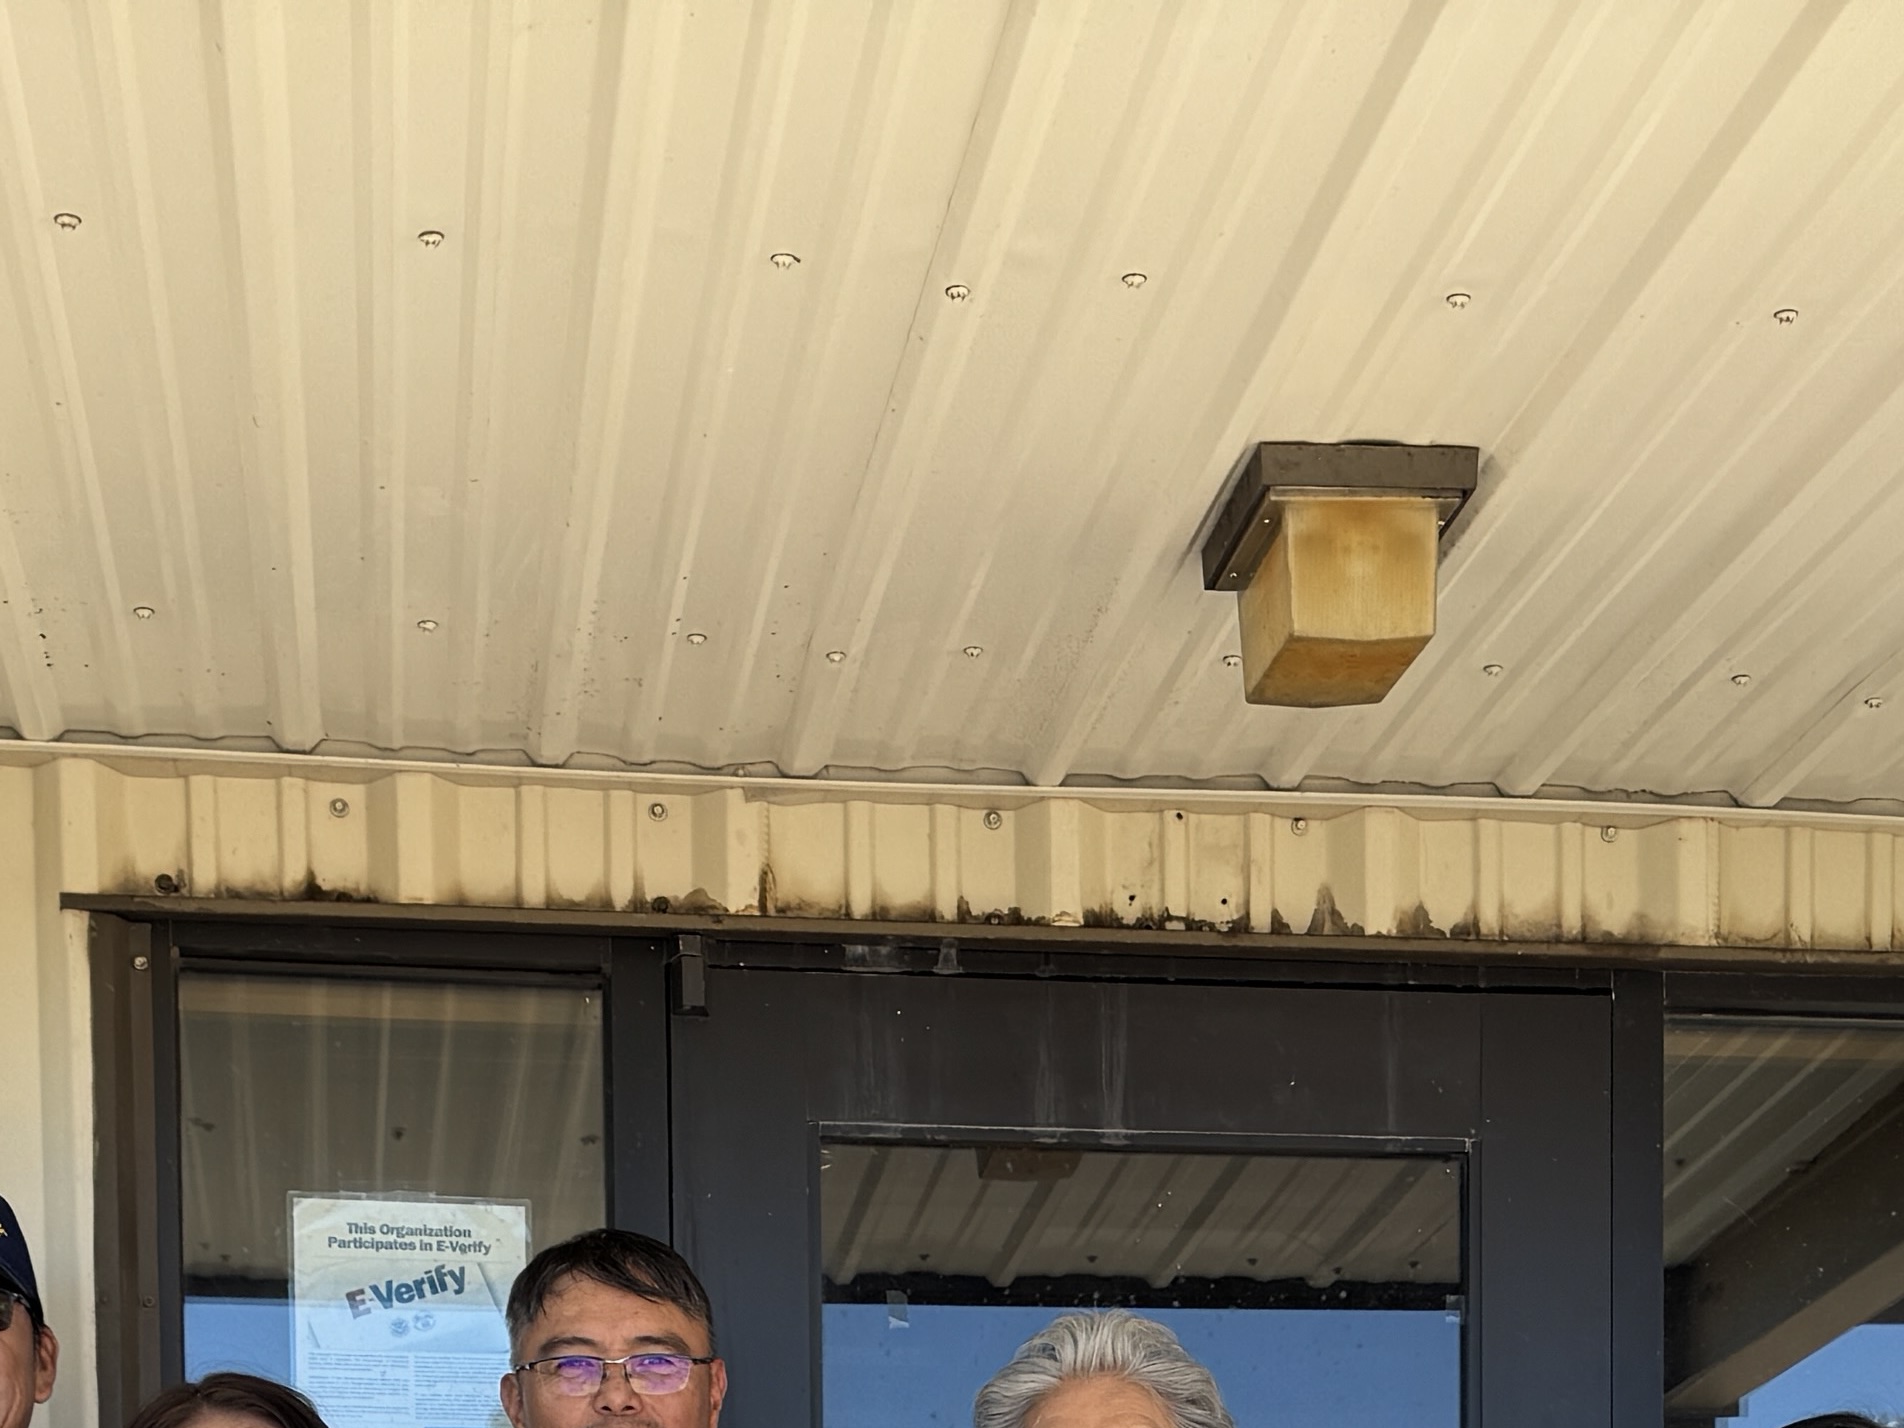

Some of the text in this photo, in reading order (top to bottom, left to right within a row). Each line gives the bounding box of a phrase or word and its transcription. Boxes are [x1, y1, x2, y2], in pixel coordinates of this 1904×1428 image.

[346, 1222, 472, 1239] This Organization
[327, 1236, 492, 1256] Participates in E-Verify
[344, 1263, 465, 1320] E-Verify
